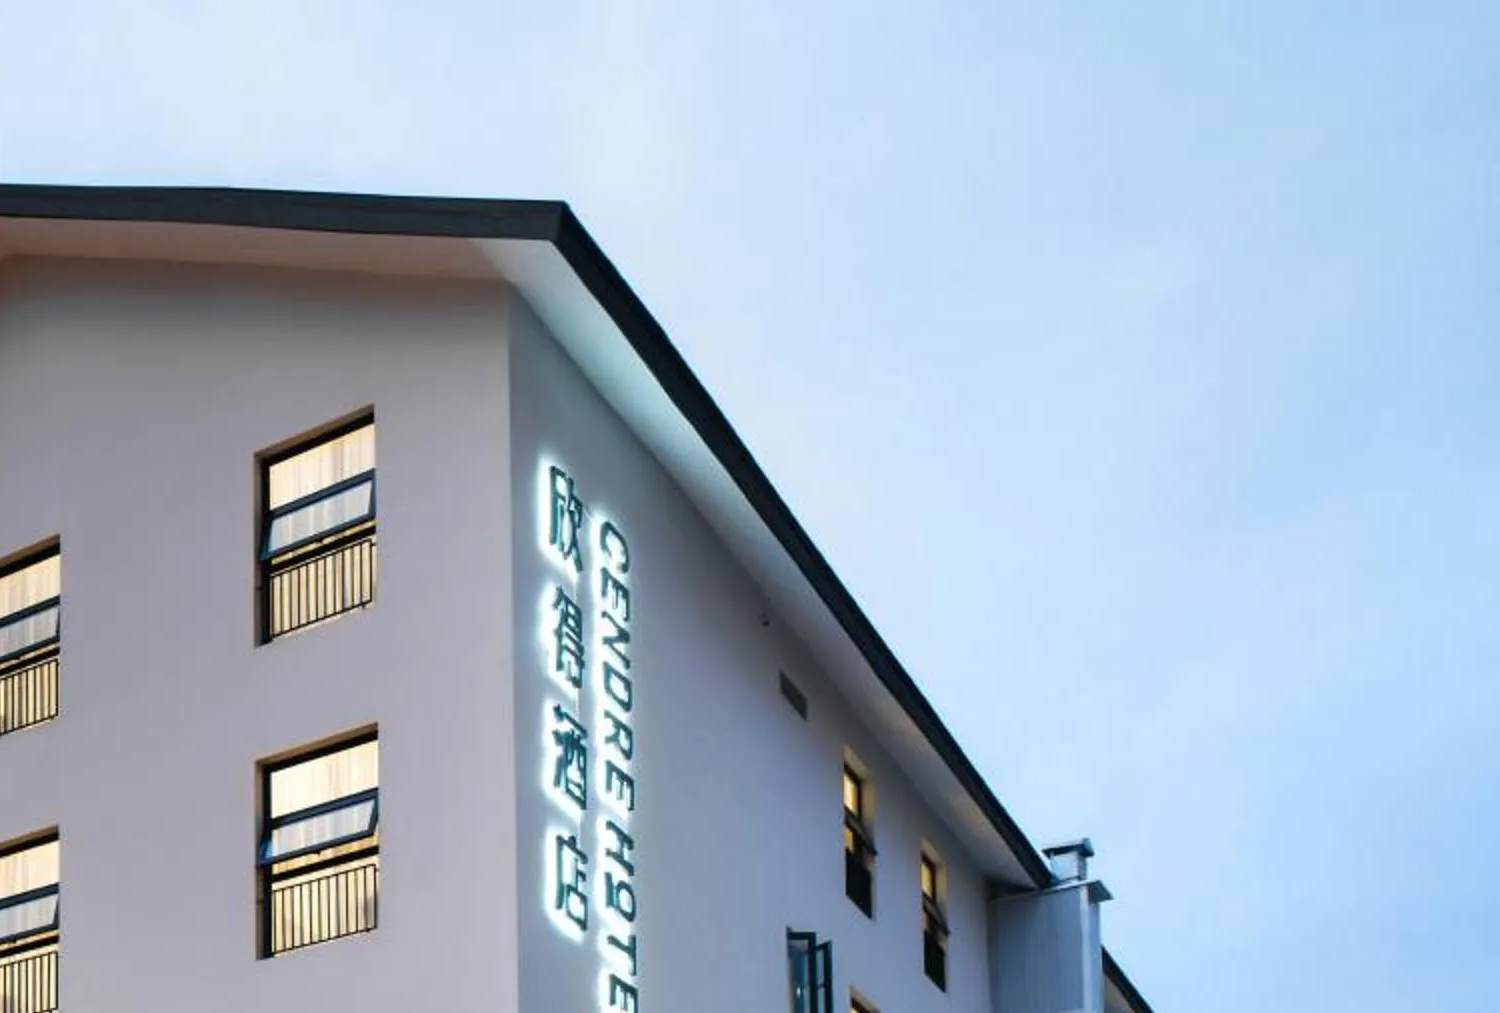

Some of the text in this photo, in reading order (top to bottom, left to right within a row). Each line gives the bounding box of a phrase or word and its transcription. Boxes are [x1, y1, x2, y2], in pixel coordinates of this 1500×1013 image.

[547, 464, 587, 932] 欣得酒店
[599, 519, 636, 811] CENDRE
